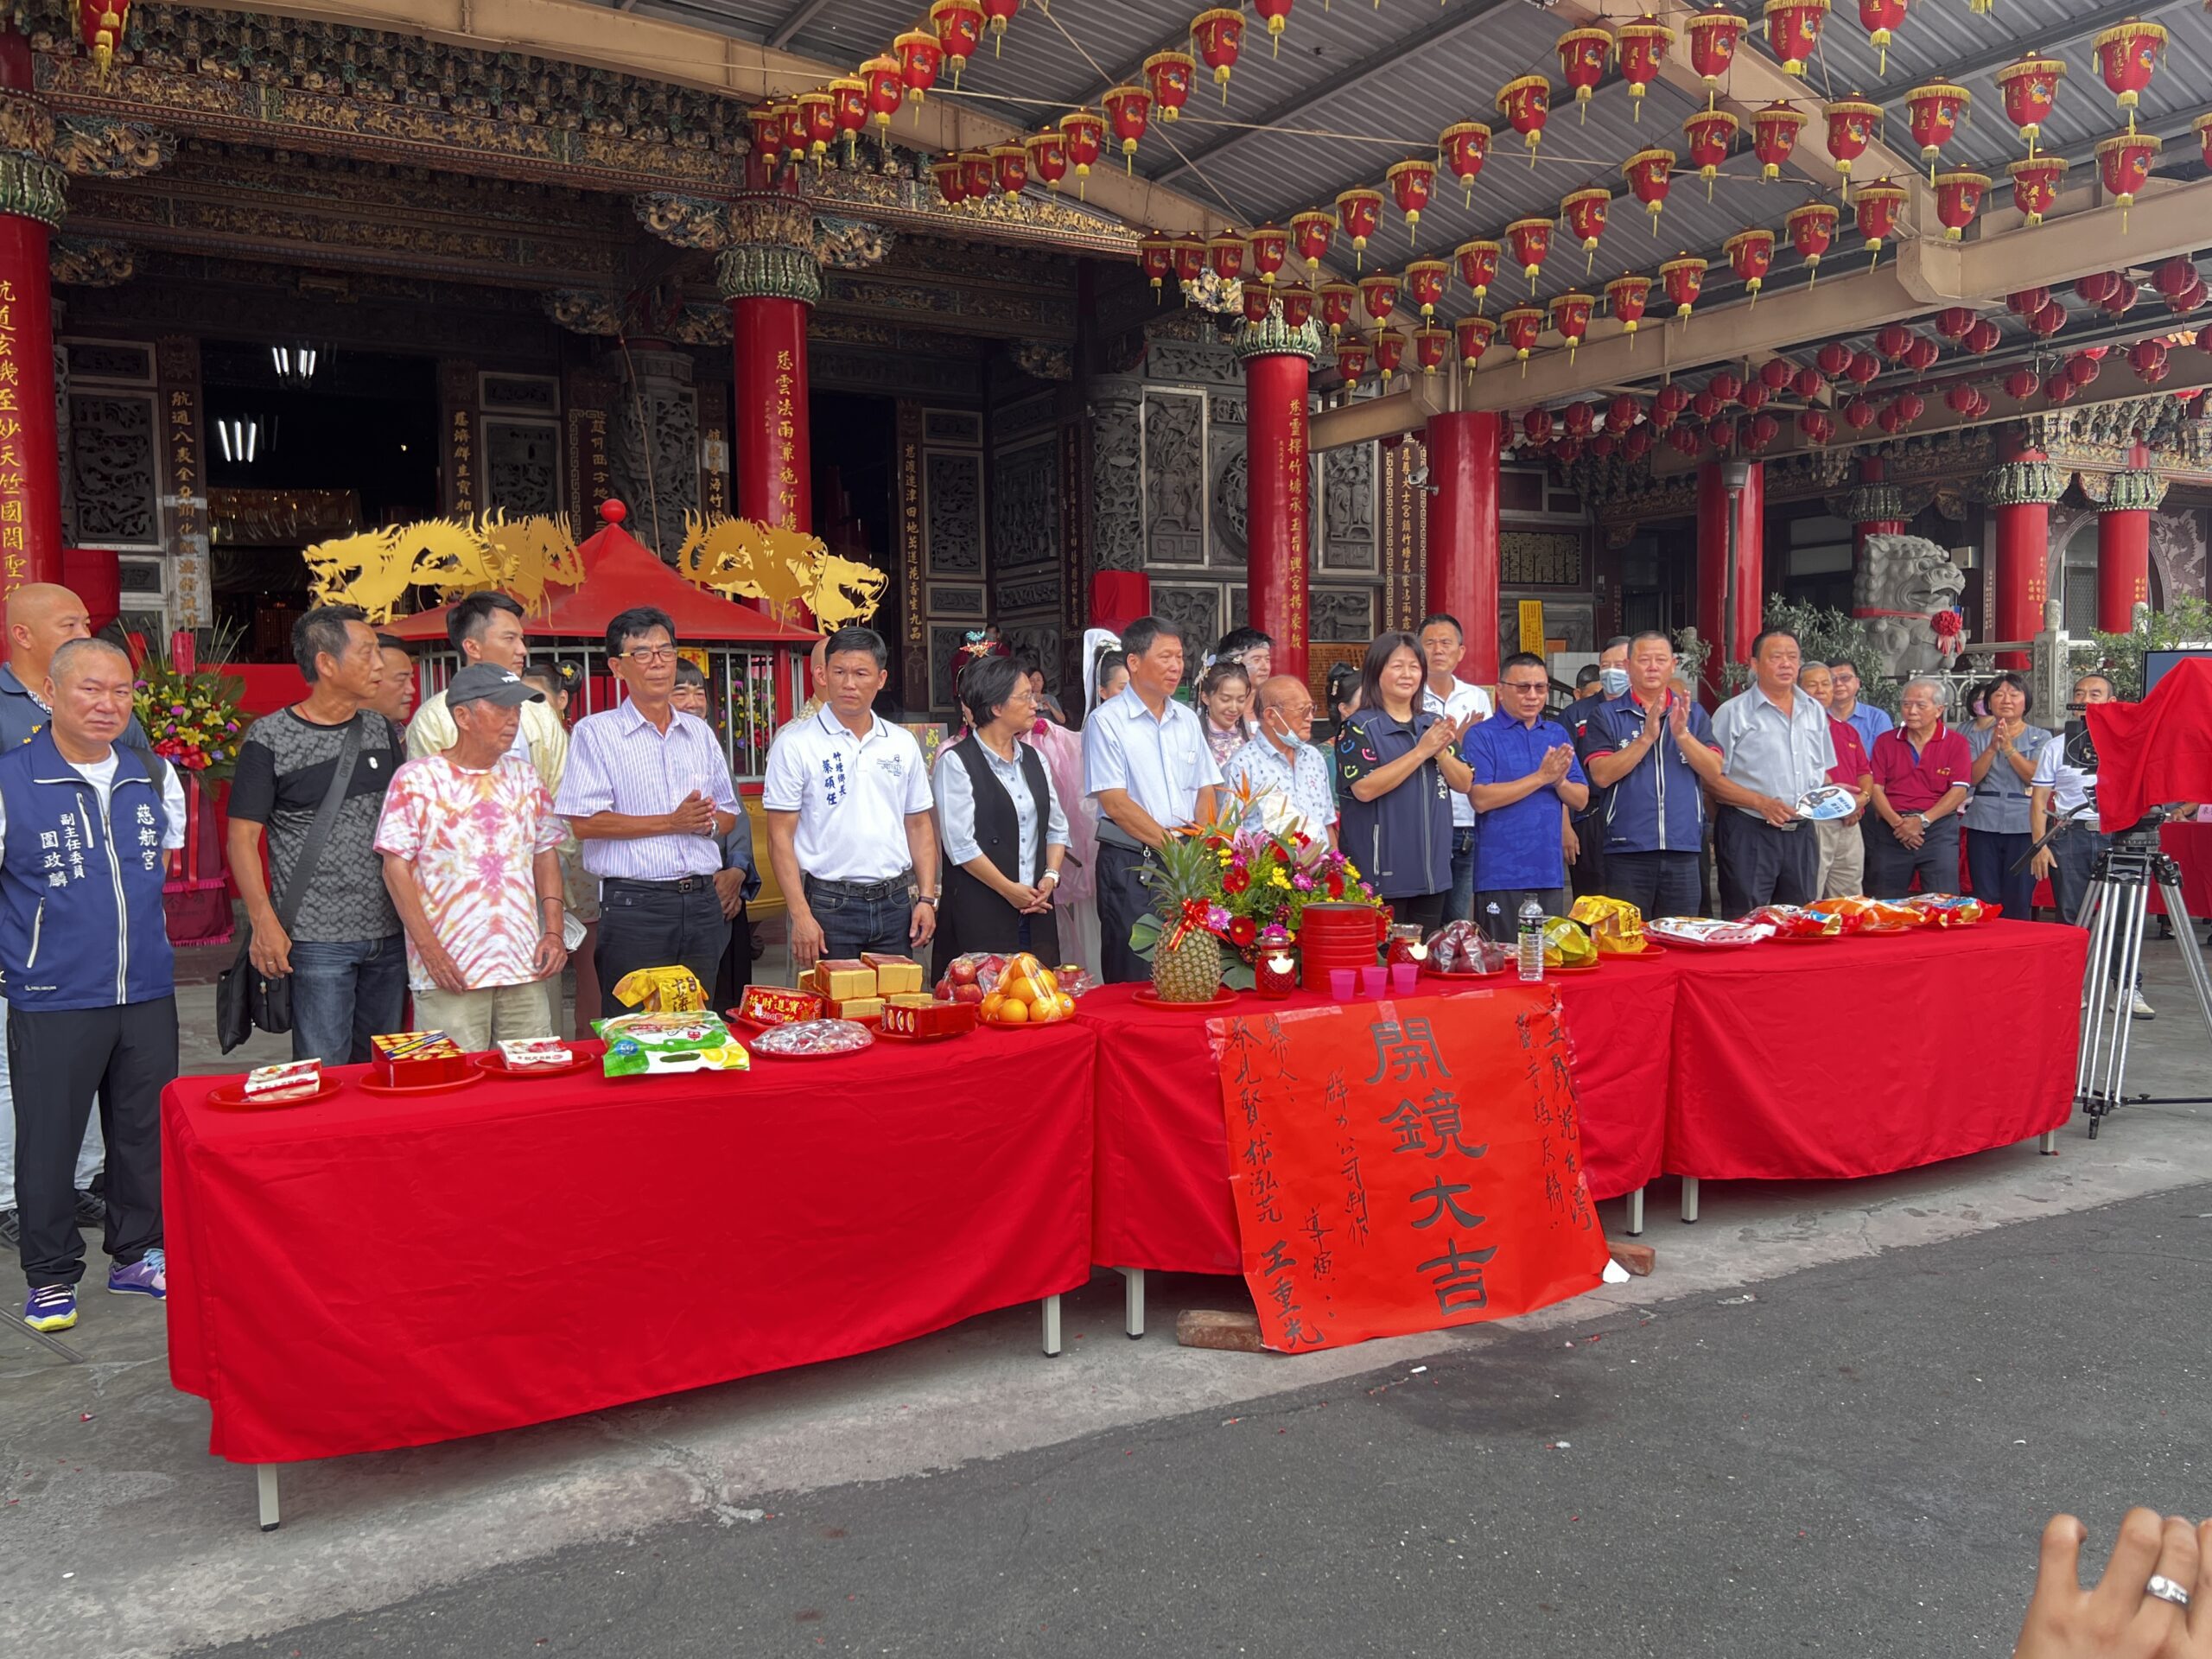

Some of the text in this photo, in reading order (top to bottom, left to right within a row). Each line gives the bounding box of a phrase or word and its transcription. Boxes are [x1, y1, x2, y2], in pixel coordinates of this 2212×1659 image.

[821, 759, 838, 806] 蔡碩任
[832, 751, 848, 798] 竹塘鄉長
[60, 812, 86, 880] 副主任委員
[136, 803, 158, 871] 慈航宮
[748, 994, 800, 1014] 招財進寶
[1364, 1016, 1498, 1317] 開鏡大吉
[1261, 1238, 1326, 1349] 王重光
